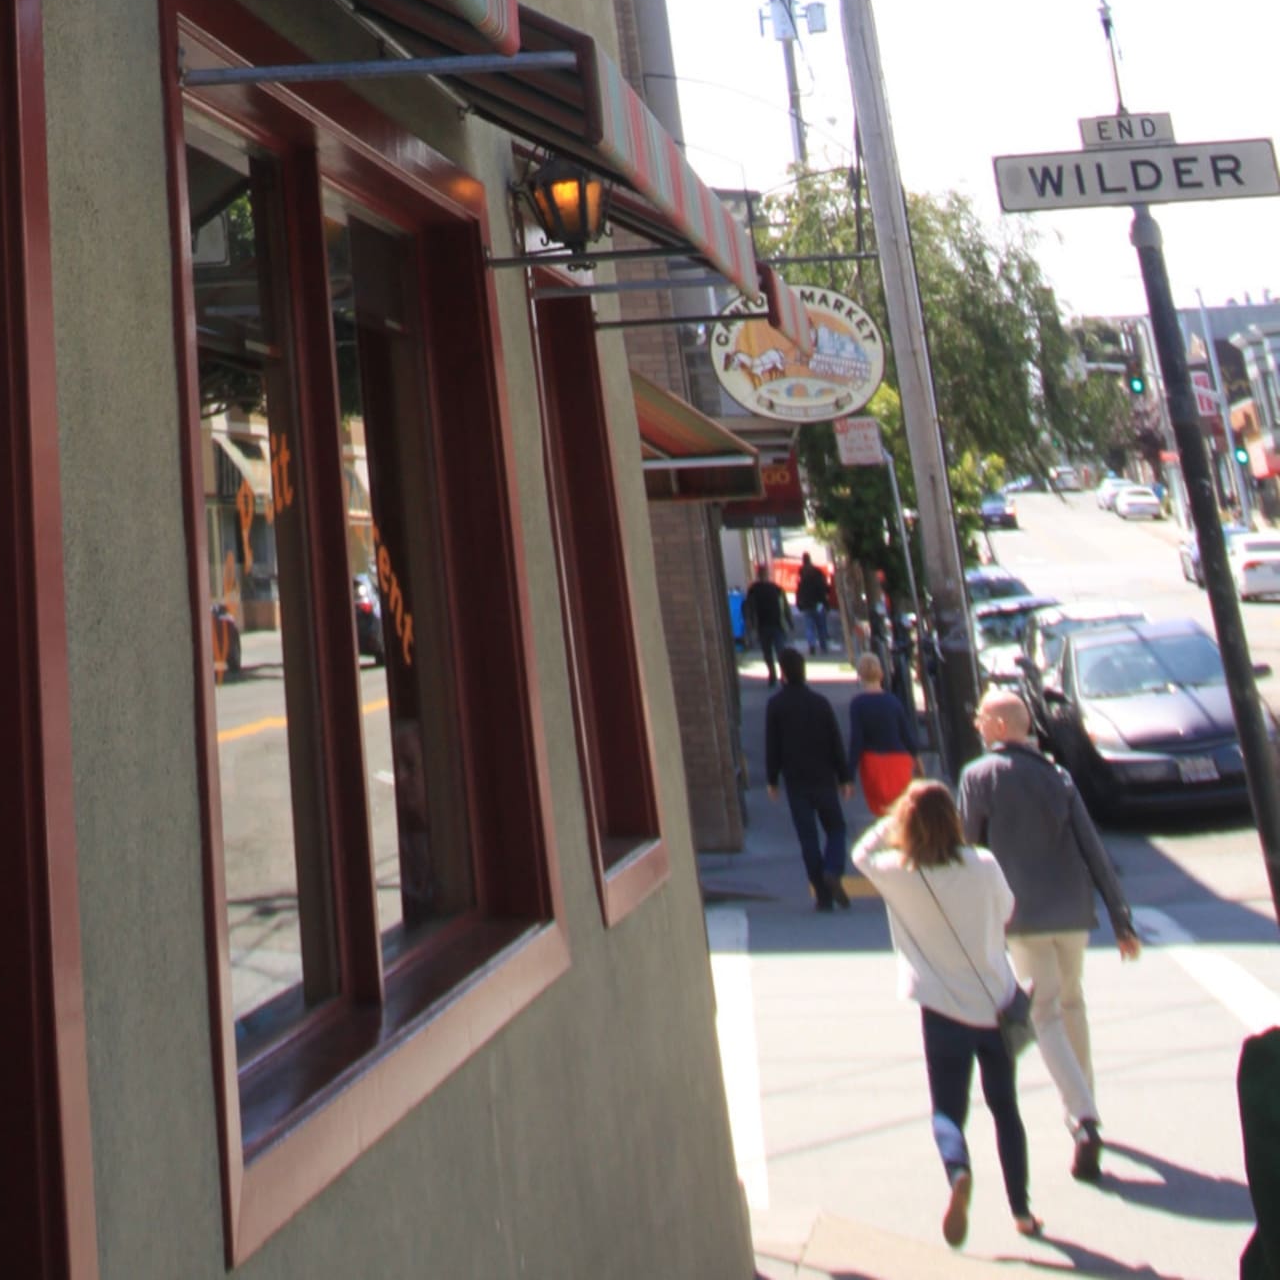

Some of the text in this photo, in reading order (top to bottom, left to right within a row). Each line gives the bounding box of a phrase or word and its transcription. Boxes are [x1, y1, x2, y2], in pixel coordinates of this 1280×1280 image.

[1096, 118, 1157, 142] END
[1027, 154, 1245, 198] WILDER
[800, 289, 877, 345] MARKET
